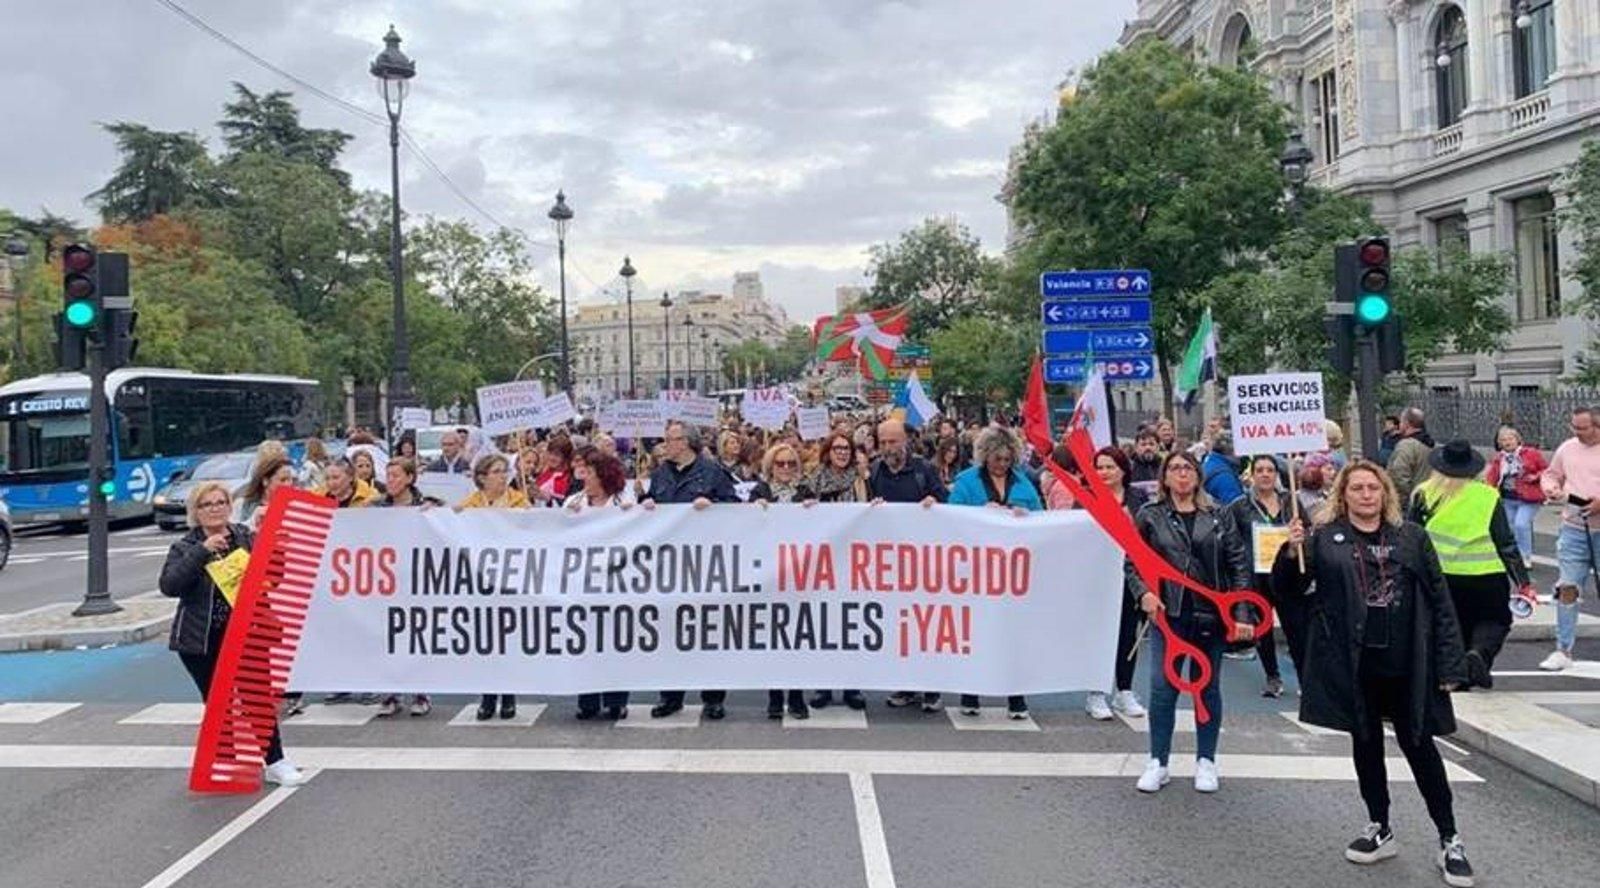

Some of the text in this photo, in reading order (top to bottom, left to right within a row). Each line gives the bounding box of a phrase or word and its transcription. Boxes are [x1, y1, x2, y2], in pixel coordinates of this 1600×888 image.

[1046, 279, 1092, 289] Valencia
[753, 388, 784, 402] IVA
[1237, 381, 1319, 398] SERVICIOS
[8, 401, 17, 415] 1
[1238, 398, 1321, 415] ESENCIALES
[1240, 421, 1323, 439] IVA AL 10%
[331, 543, 1031, 597] SOS IMAGEN PERSONAL: IVA REDUCIDO
[387, 602, 972, 657] PRESUPUESTOS GENERALES ¡YA!
